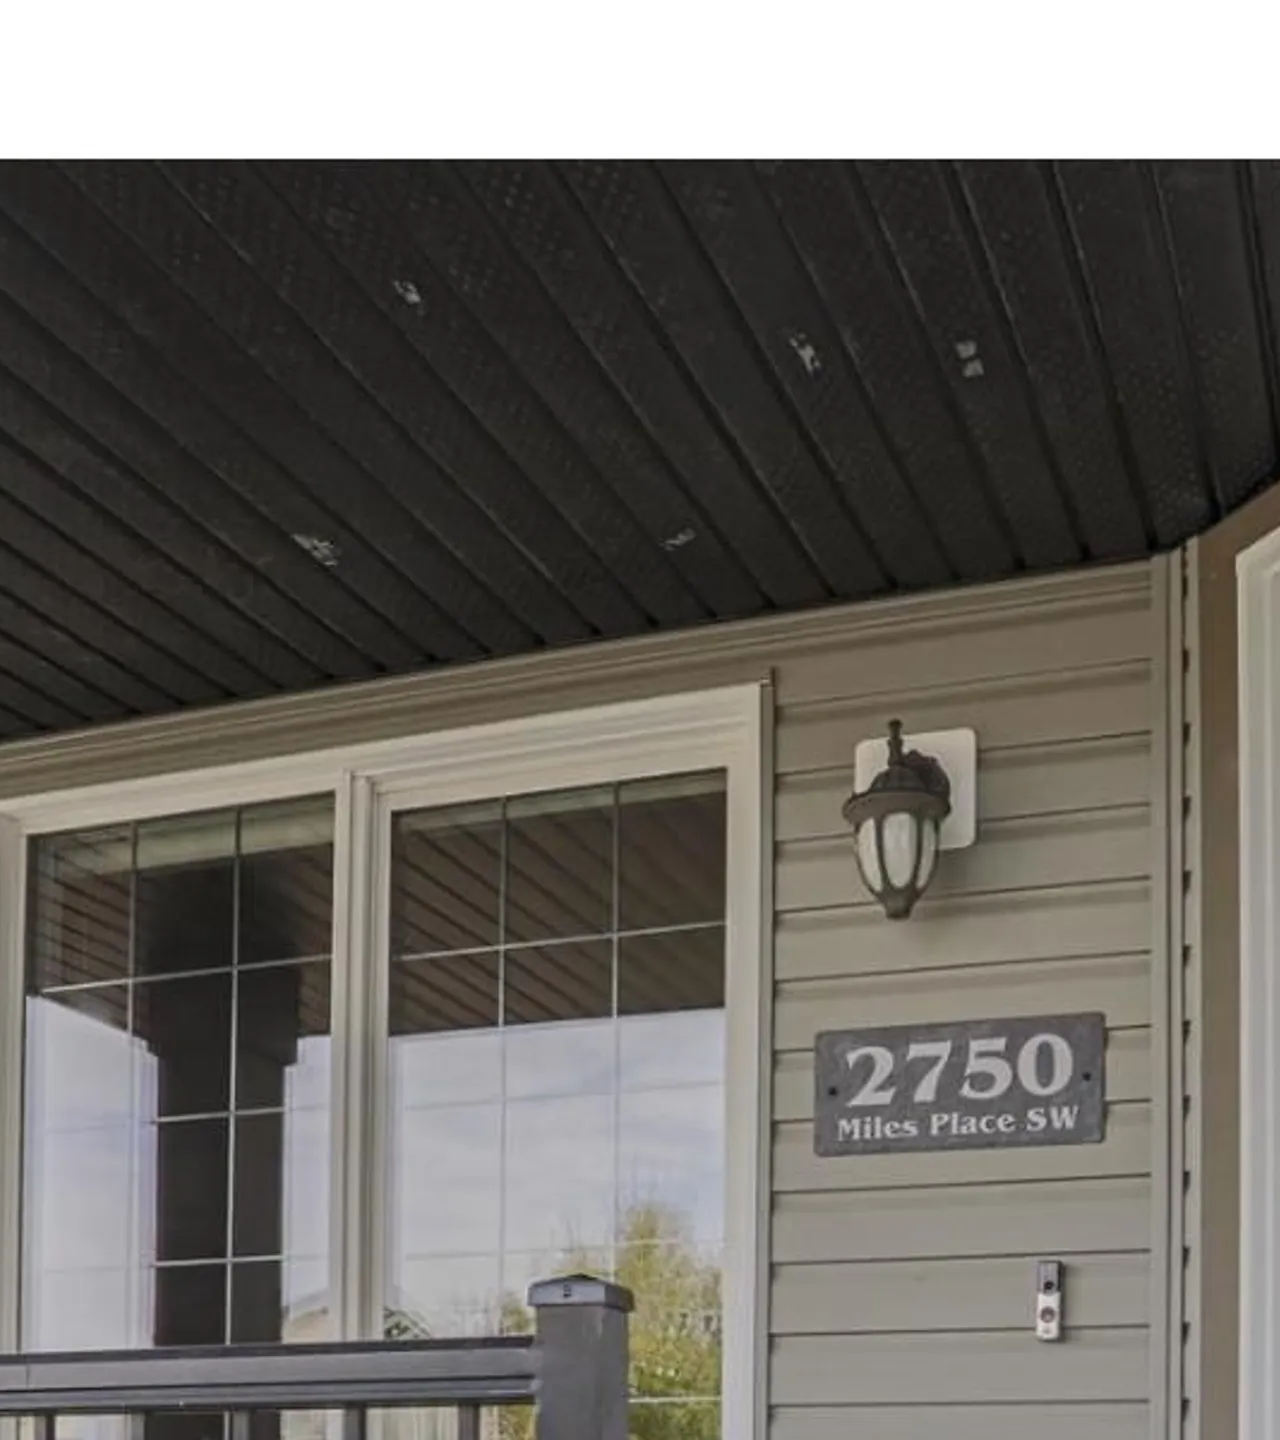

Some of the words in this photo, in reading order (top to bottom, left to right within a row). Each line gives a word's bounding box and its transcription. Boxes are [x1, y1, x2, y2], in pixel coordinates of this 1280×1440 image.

[845, 1033, 1073, 1107] 2750
[838, 1116, 919, 1142] Miles
[930, 1111, 1016, 1136] Place
[1026, 1104, 1078, 1132] SW
